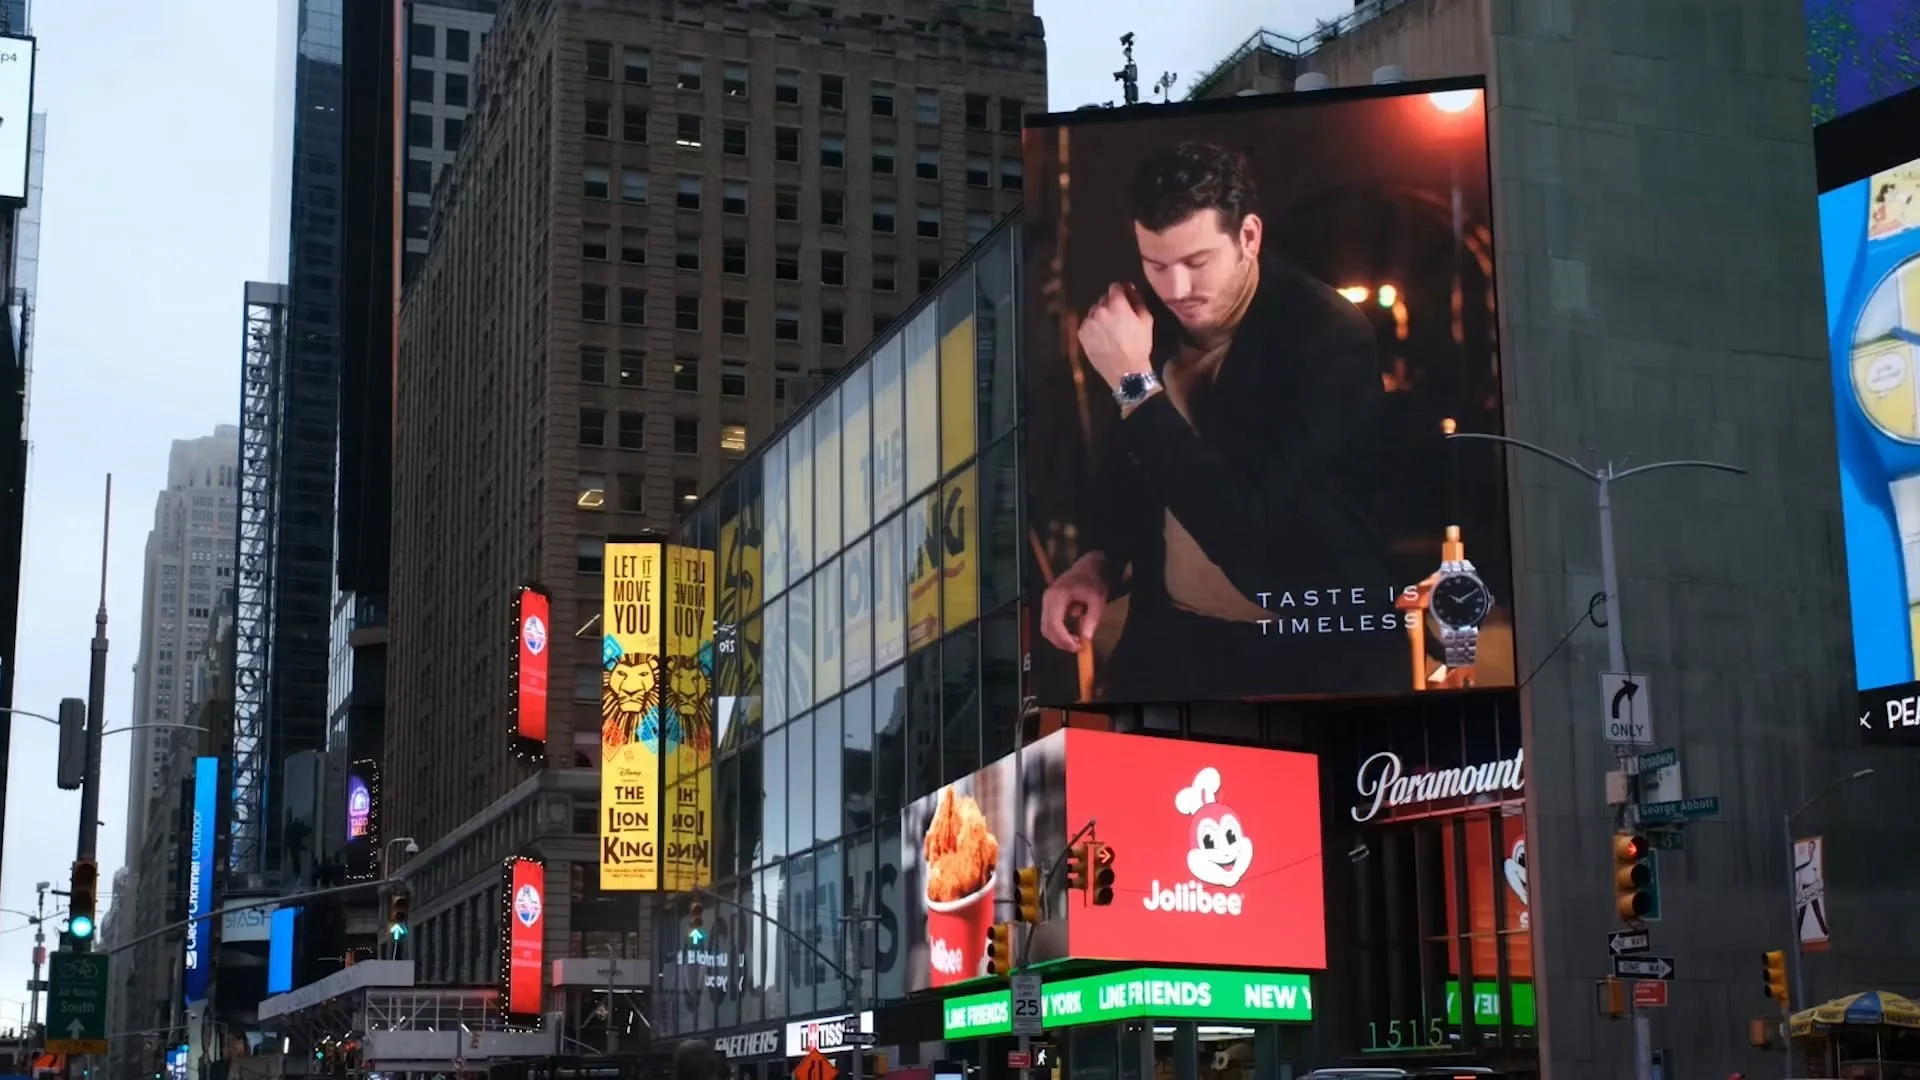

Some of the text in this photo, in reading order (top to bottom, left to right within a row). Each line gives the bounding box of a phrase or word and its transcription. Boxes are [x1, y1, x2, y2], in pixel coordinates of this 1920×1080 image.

[0, 52, 17, 64] p4
[614, 555, 652, 578] LET IT
[613, 580, 651, 602] MOVE
[1256, 584, 1421, 609] TASTE IS
[614, 604, 650, 635] YOU
[1256, 611, 1421, 636] TIMELESS
[1611, 723, 1645, 738] ONLY
[614, 786, 644, 800] THE
[1351, 747, 1524, 822] Paramount
[1641, 798, 1714, 816] George Abbott
[603, 836, 653, 864] KING
[1143, 879, 1238, 916] Jollibee
[1623, 963, 1666, 974] ONE WAY
[60, 1000, 95, 1014] South
[1015, 1000, 1039, 1016] 25
[1051, 990, 1082, 1017] YORK
[1099, 983, 1127, 1010] LINE
[1128, 980, 1212, 1008] FRIENDS
[1244, 984, 1297, 1009] NEW
[945, 1000, 1008, 1030] LINE FRIENDS
[715, 1029, 778, 1058] SKECHERS
[820, 1021, 845, 1049] TISS
[1369, 1017, 1443, 1049] 1515
